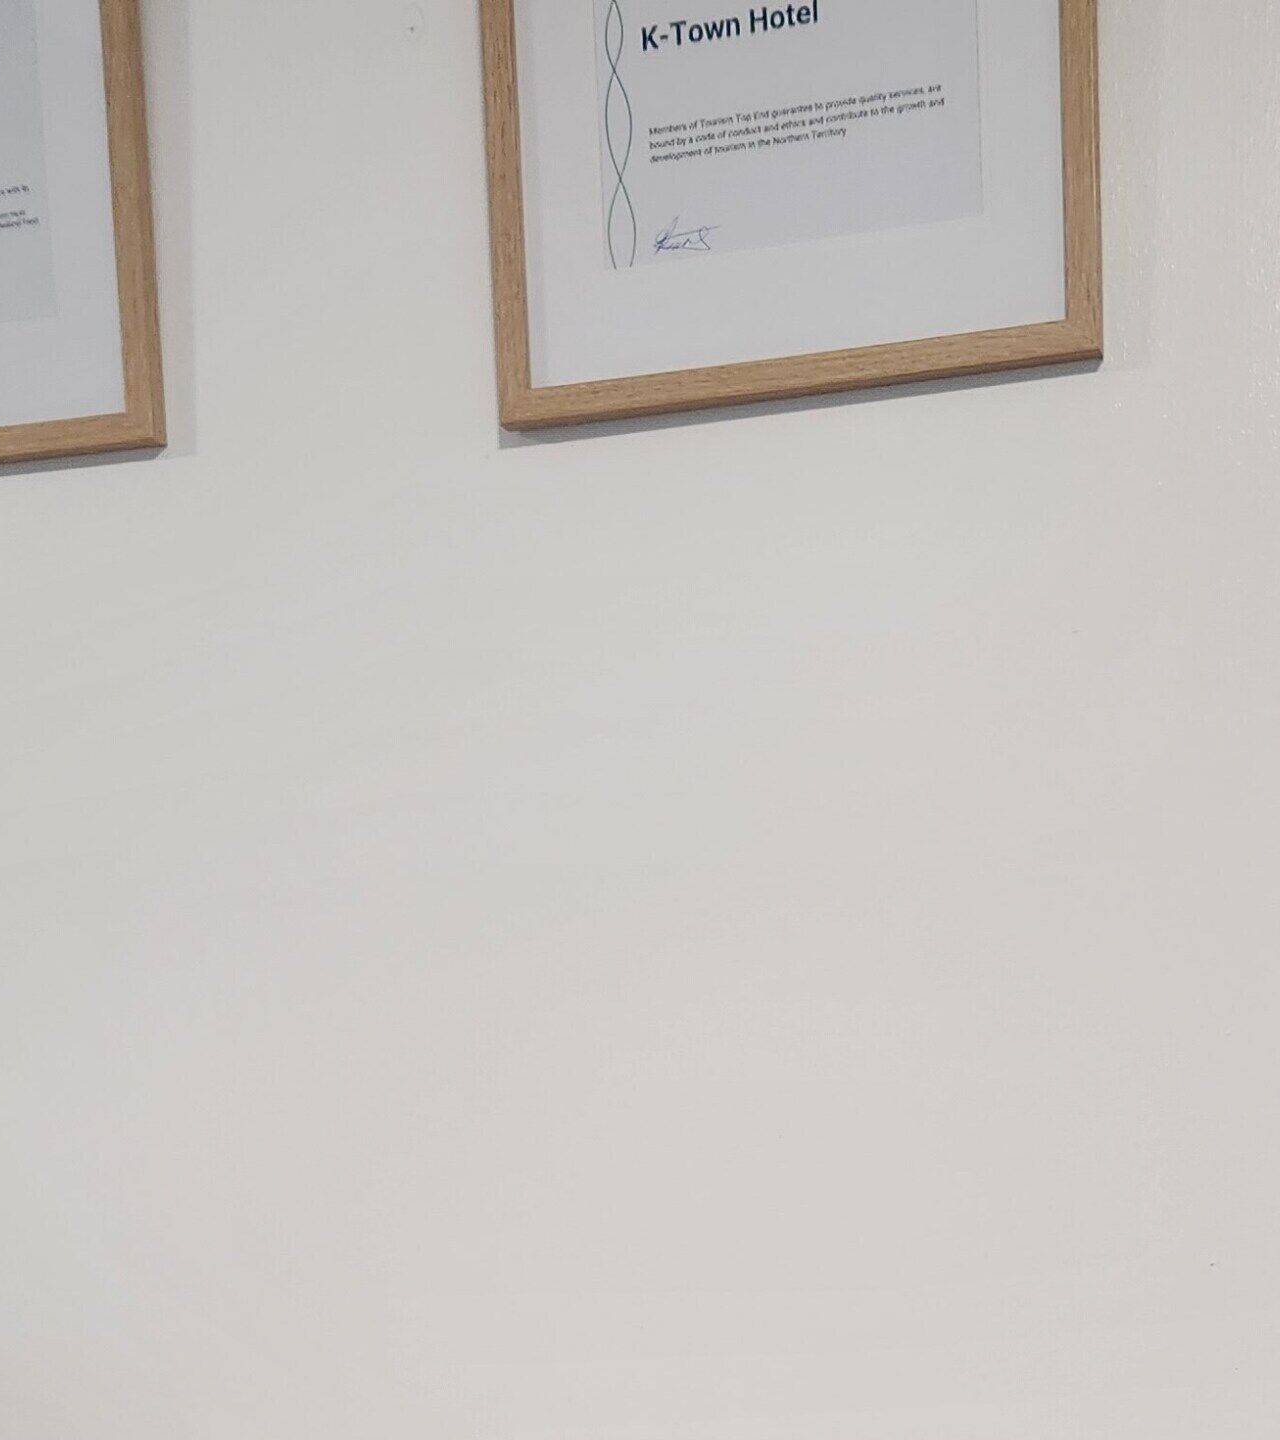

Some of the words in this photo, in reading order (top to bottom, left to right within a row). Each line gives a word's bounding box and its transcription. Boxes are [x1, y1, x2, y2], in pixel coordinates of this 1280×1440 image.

[641, 17, 741, 51] K-Town
[749, 0, 818, 34] Hotel
[649, 124, 687, 135] Members
[700, 116, 733, 128] Tourism
[736, 114, 752, 123] Top
[754, 110, 769, 120] End
[771, 104, 813, 118] guarantee
[826, 98, 857, 111] provide
[859, 93, 886, 105] quality
[649, 139, 674, 149] bound
[676, 137, 686, 147] by
[695, 132, 715, 142] code
[728, 126, 761, 137] conduct
[764, 123, 778, 132] and
[781, 119, 806, 130] ethics
[809, 116, 823, 125] and
[826, 110, 868, 123] contribute
[881, 106, 894, 114] the
[897, 101, 926, 113] growth
[929, 98, 945, 107] and
[650, 149, 702, 164] development
[715, 142, 746, 154] tourism
[758, 139, 770, 147] the
[773, 133, 809, 145] Northern
[812, 128, 846, 142] Territory
